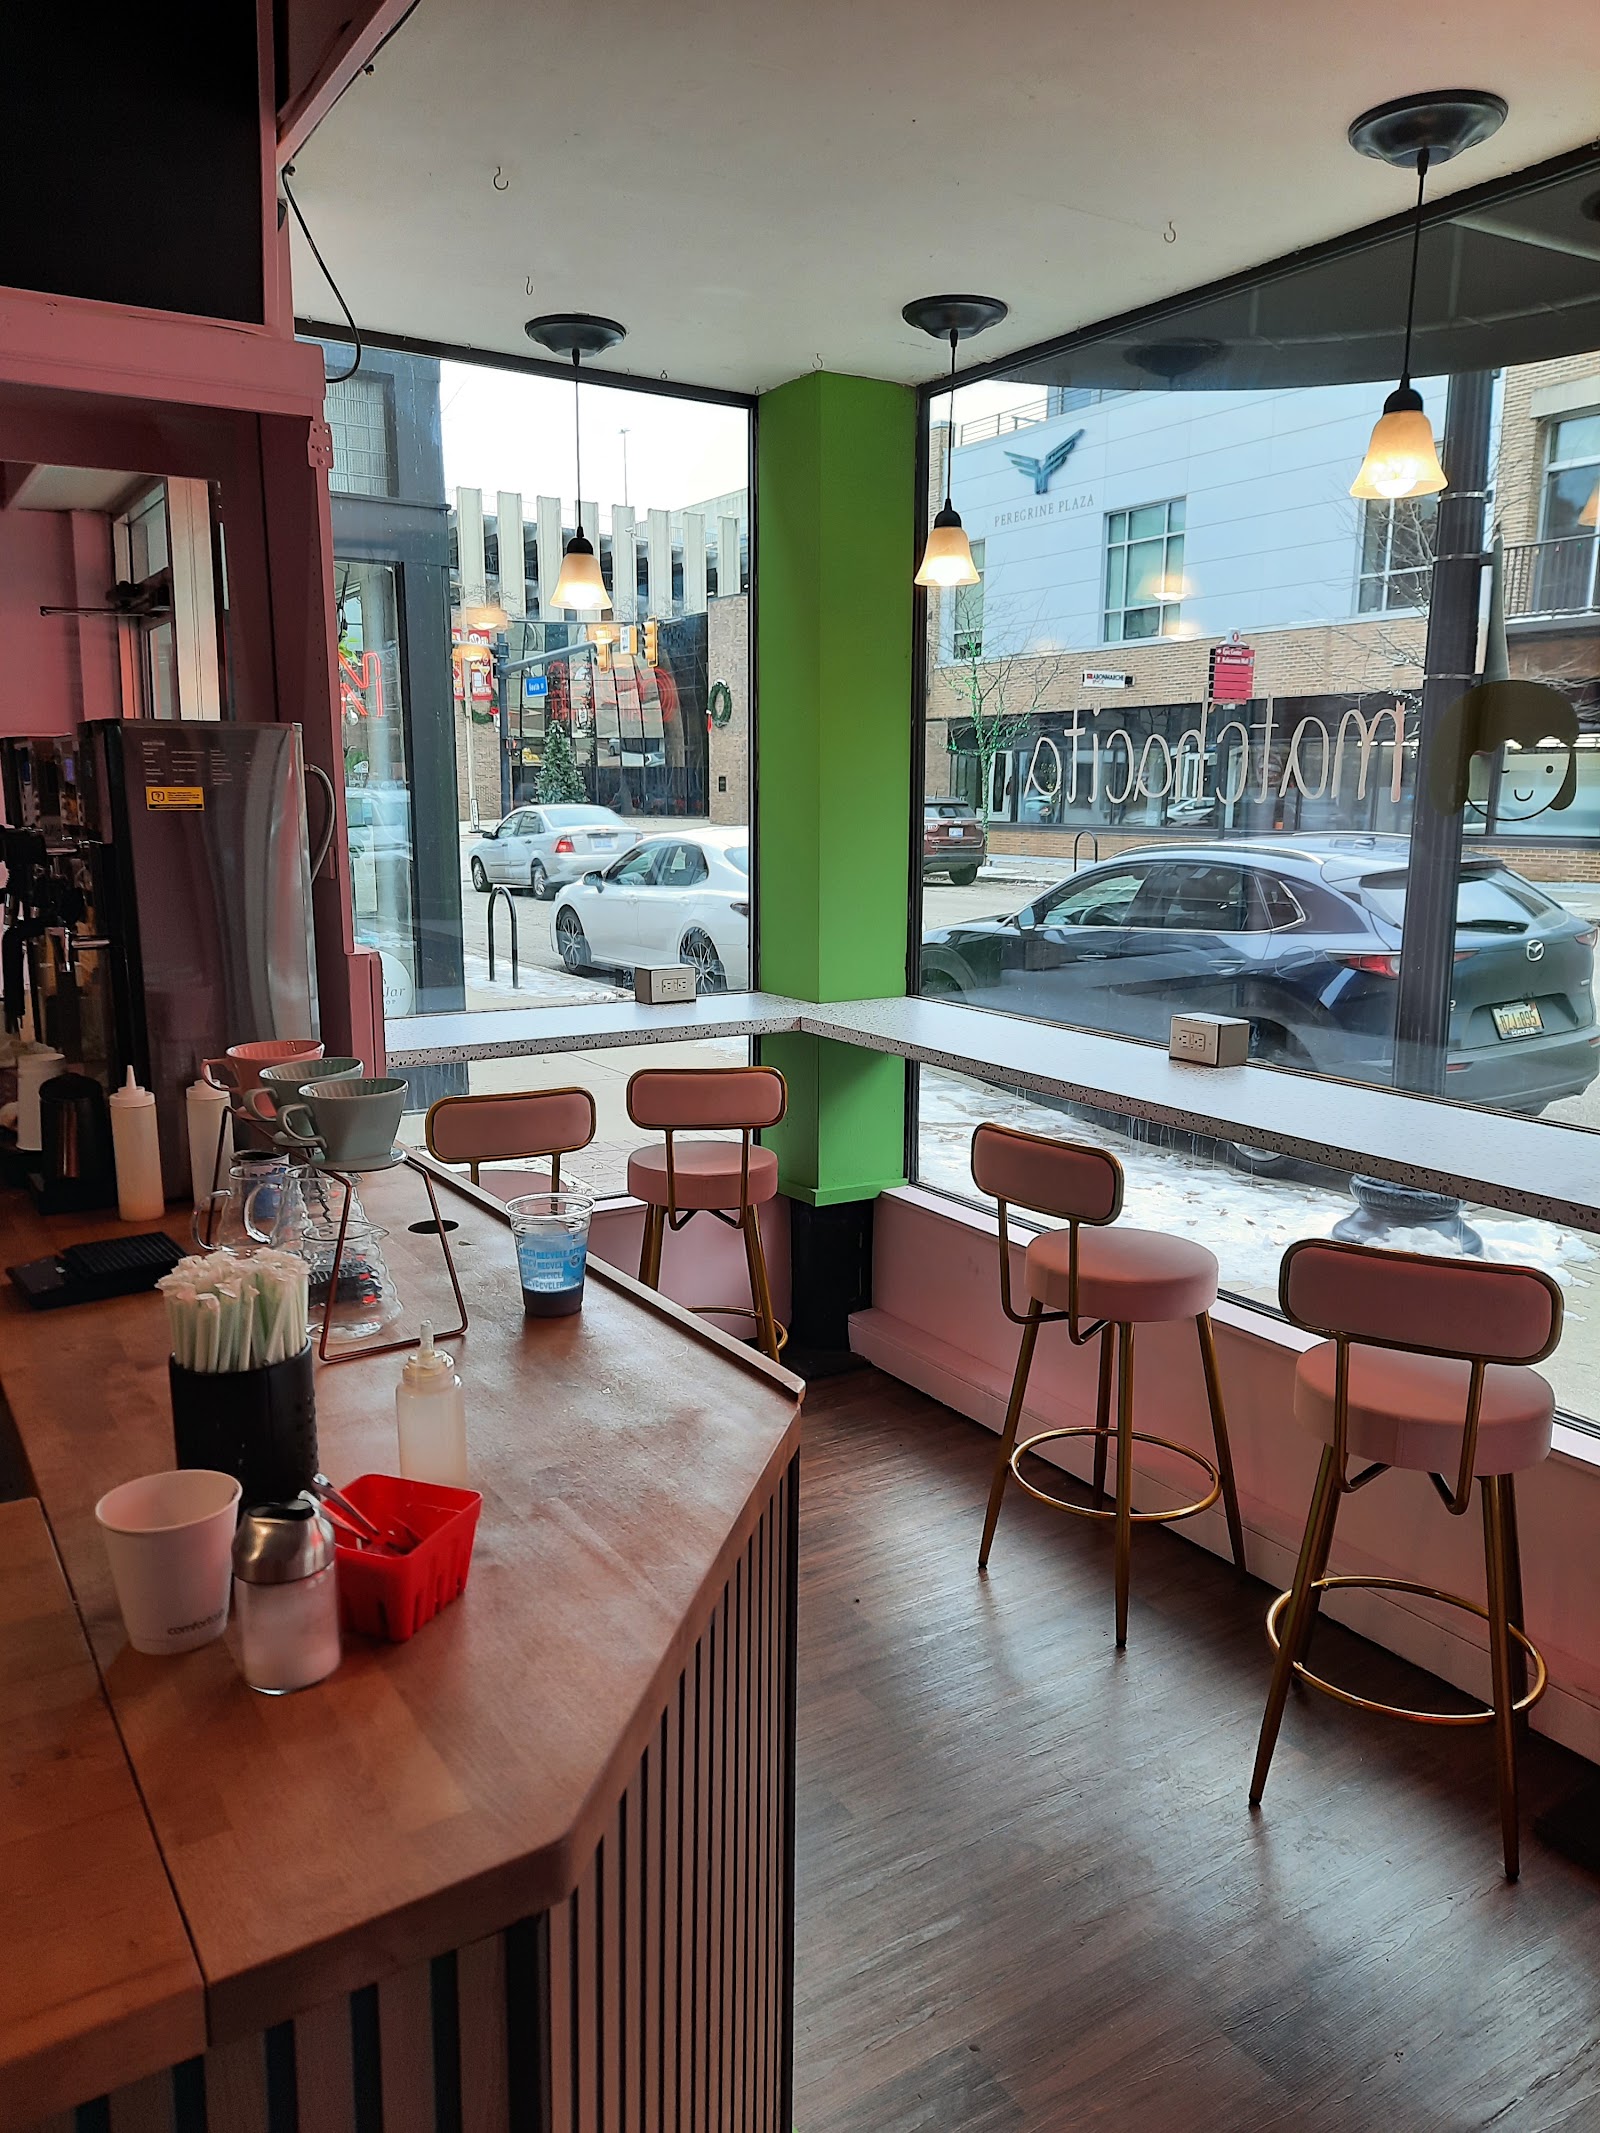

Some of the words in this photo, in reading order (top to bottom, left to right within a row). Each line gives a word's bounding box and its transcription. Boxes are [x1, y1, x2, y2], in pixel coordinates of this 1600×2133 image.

[994, 502, 1054, 527] PEREGRINE
[1058, 494, 1094, 513] PLAZA
[385, 986, 406, 998] Jar
